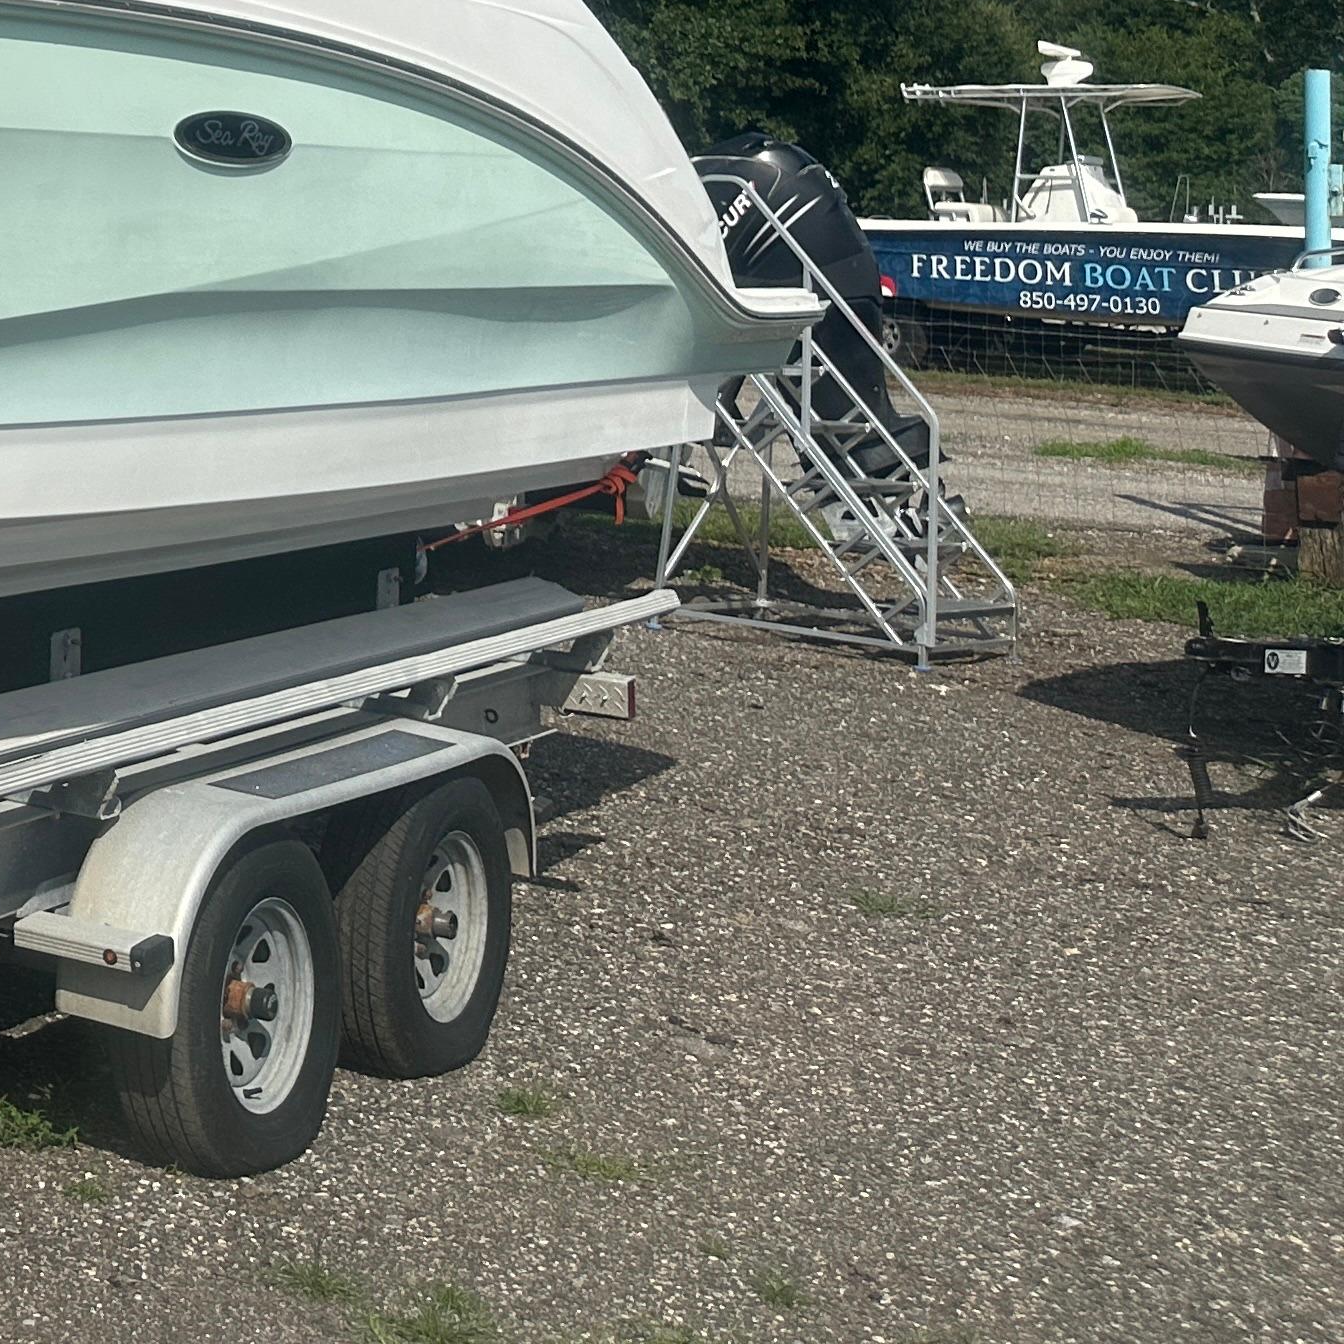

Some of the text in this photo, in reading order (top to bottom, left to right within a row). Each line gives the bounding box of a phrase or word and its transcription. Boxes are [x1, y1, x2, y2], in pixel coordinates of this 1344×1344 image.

[197, 120, 273, 155] Sea Ray
[964, 240, 983, 252] WE
[987, 241, 1011, 253] BUY
[1014, 242, 1040, 255] THE
[1043, 244, 1086, 256] BOATS
[1099, 246, 1126, 259] YOU
[1130, 248, 1173, 261] ENJOY
[1177, 250, 1220, 264] THEM!
[911, 253, 1073, 287] FREEDOM
[1083, 263, 1177, 292] BOAT
[1019, 290, 1161, 315] 850-497-0130
